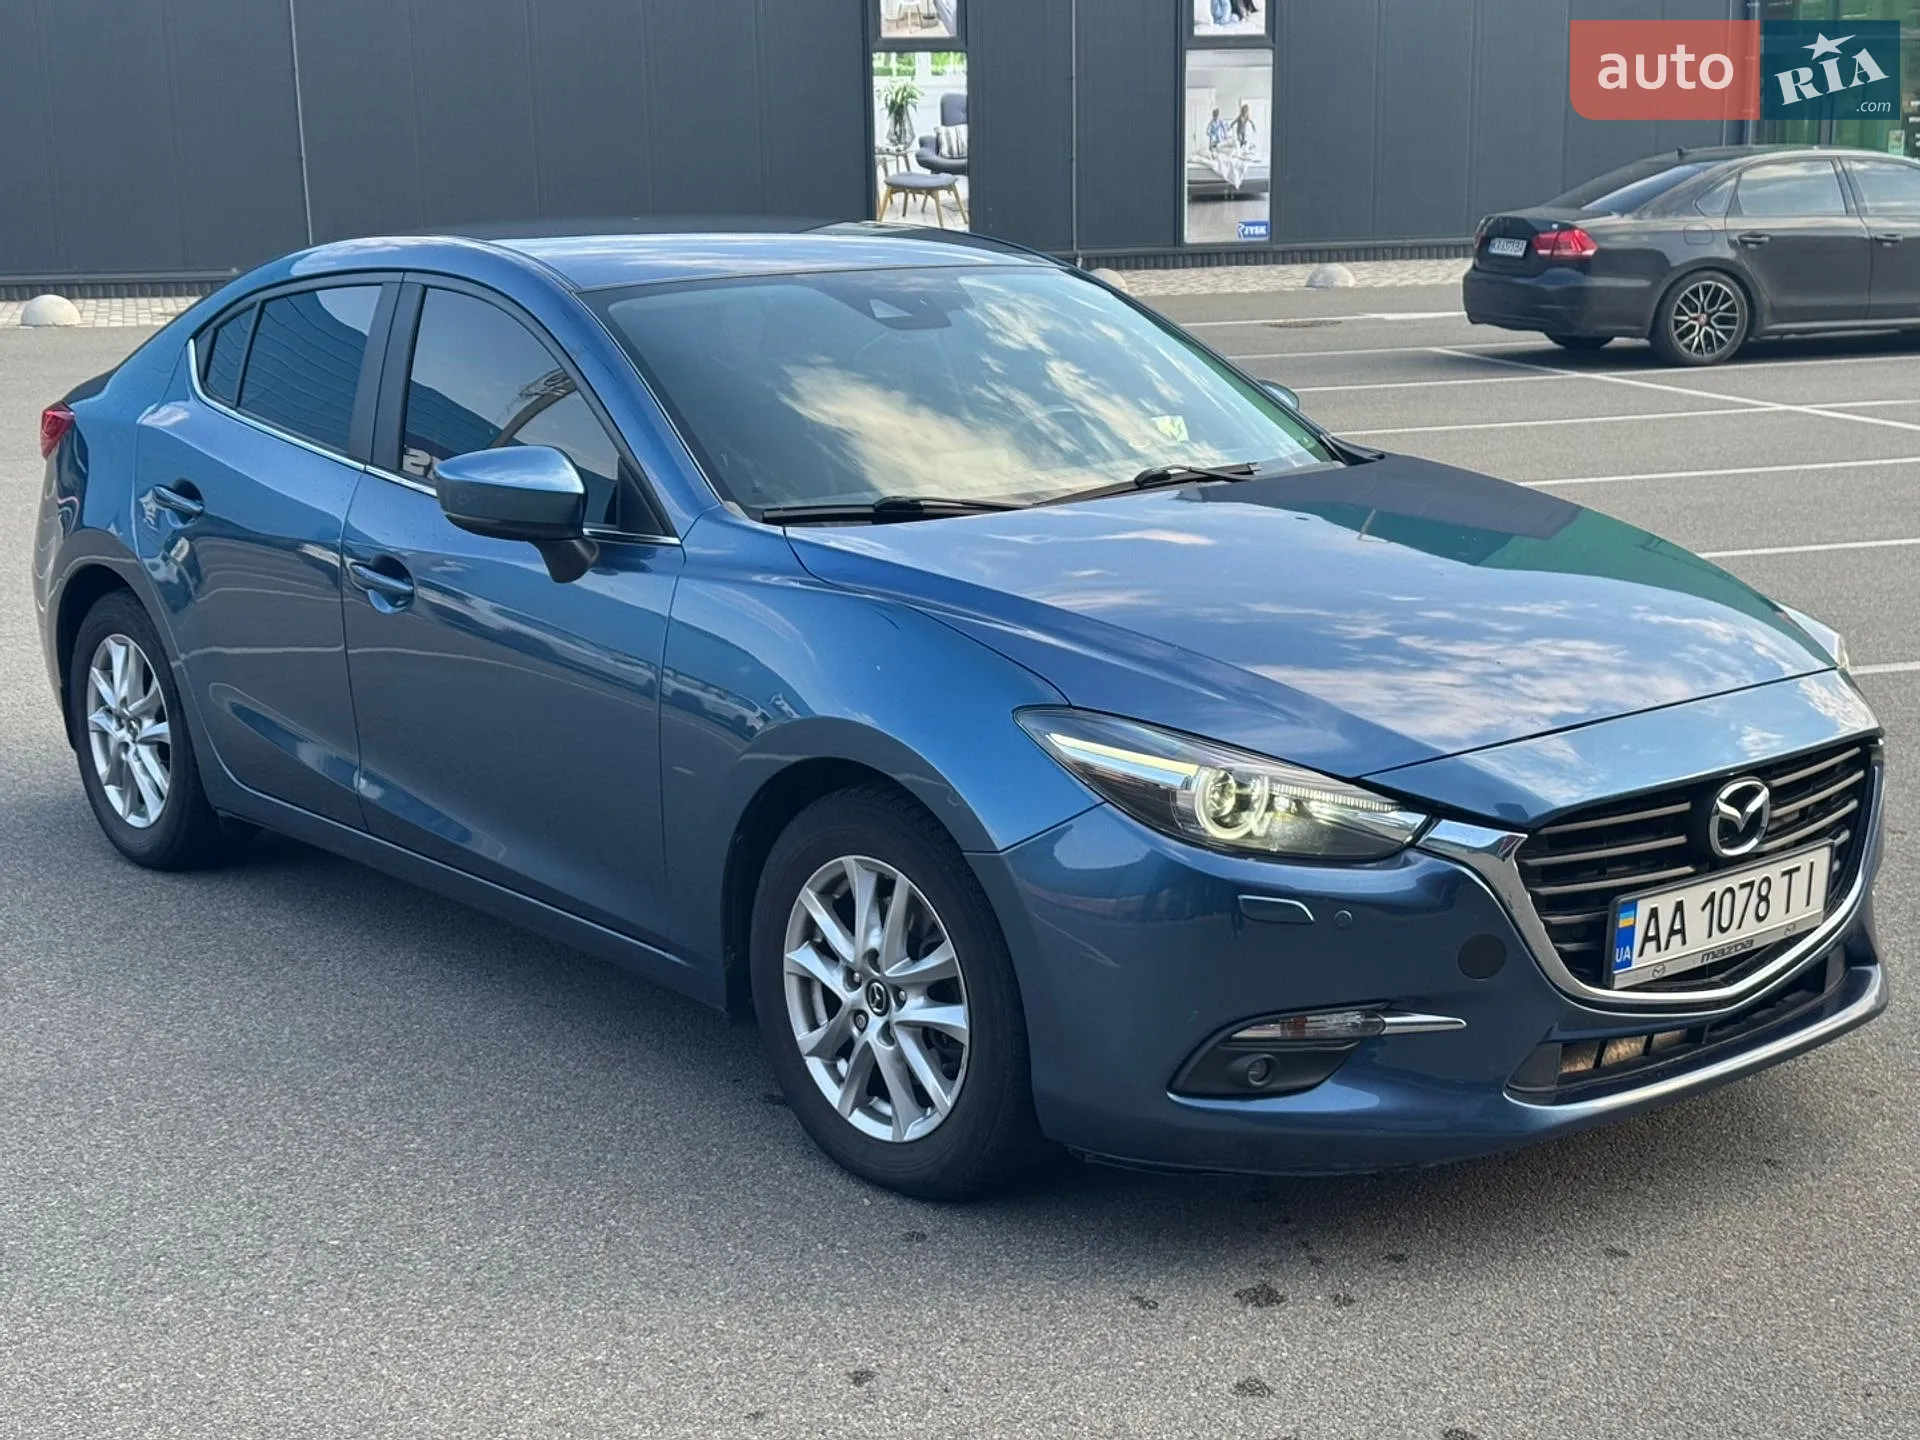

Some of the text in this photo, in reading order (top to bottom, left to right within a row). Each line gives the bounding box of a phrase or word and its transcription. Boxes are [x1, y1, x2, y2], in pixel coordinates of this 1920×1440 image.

[1638, 860, 1815, 957] AA 1078 TI
[1615, 945, 1632, 963] UA
